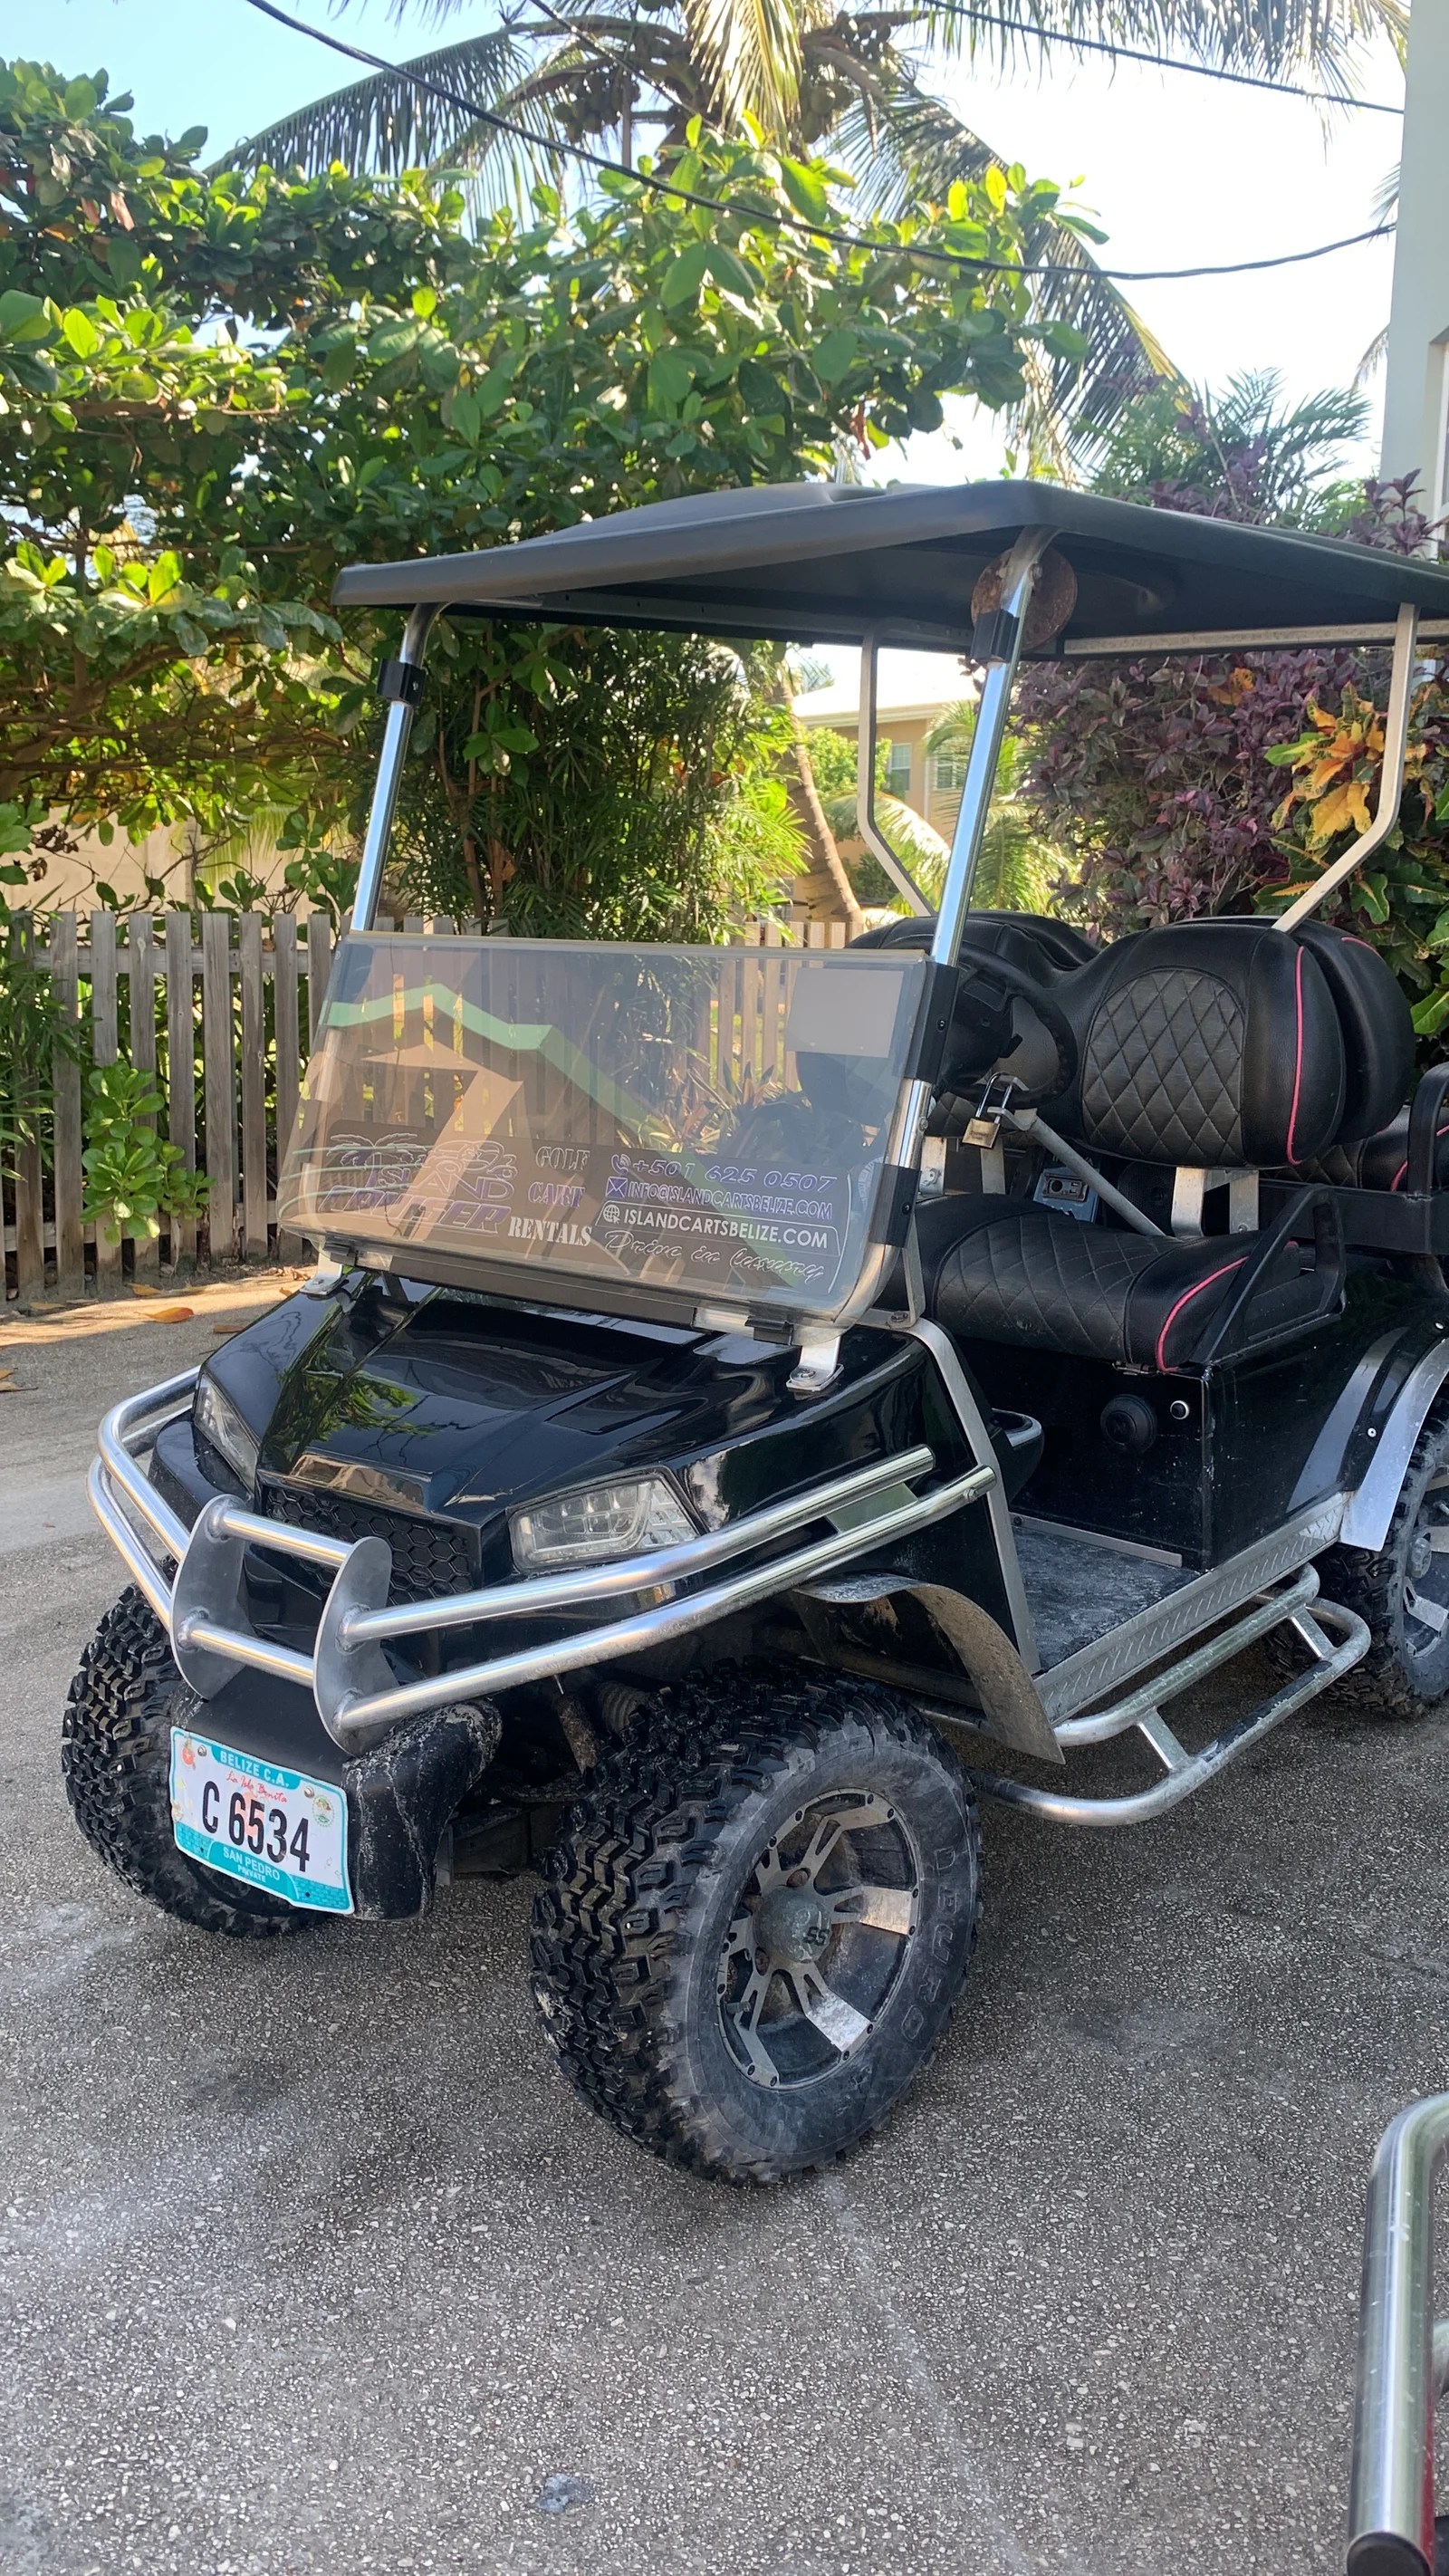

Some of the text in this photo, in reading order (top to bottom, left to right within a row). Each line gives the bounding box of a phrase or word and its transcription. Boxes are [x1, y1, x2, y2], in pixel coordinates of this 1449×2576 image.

[535, 1145, 590, 1171] GOLF
[633, 1159, 838, 1193] +501 625 0507
[528, 1181, 586, 1208] CART
[508, 1216, 592, 1247] RENTALS
[624, 1208, 828, 1249] ISLANDCARTSBELIZE.COM
[604, 1229, 682, 1261] Drive
[691, 1245, 721, 1263] in
[220, 1751, 290, 1787] BELIZE C.A.
[202, 1781, 310, 1872] C 6534
[223, 1847, 281, 1881] SAN PEDRO
[238, 1864, 267, 1883] PRIVATE
